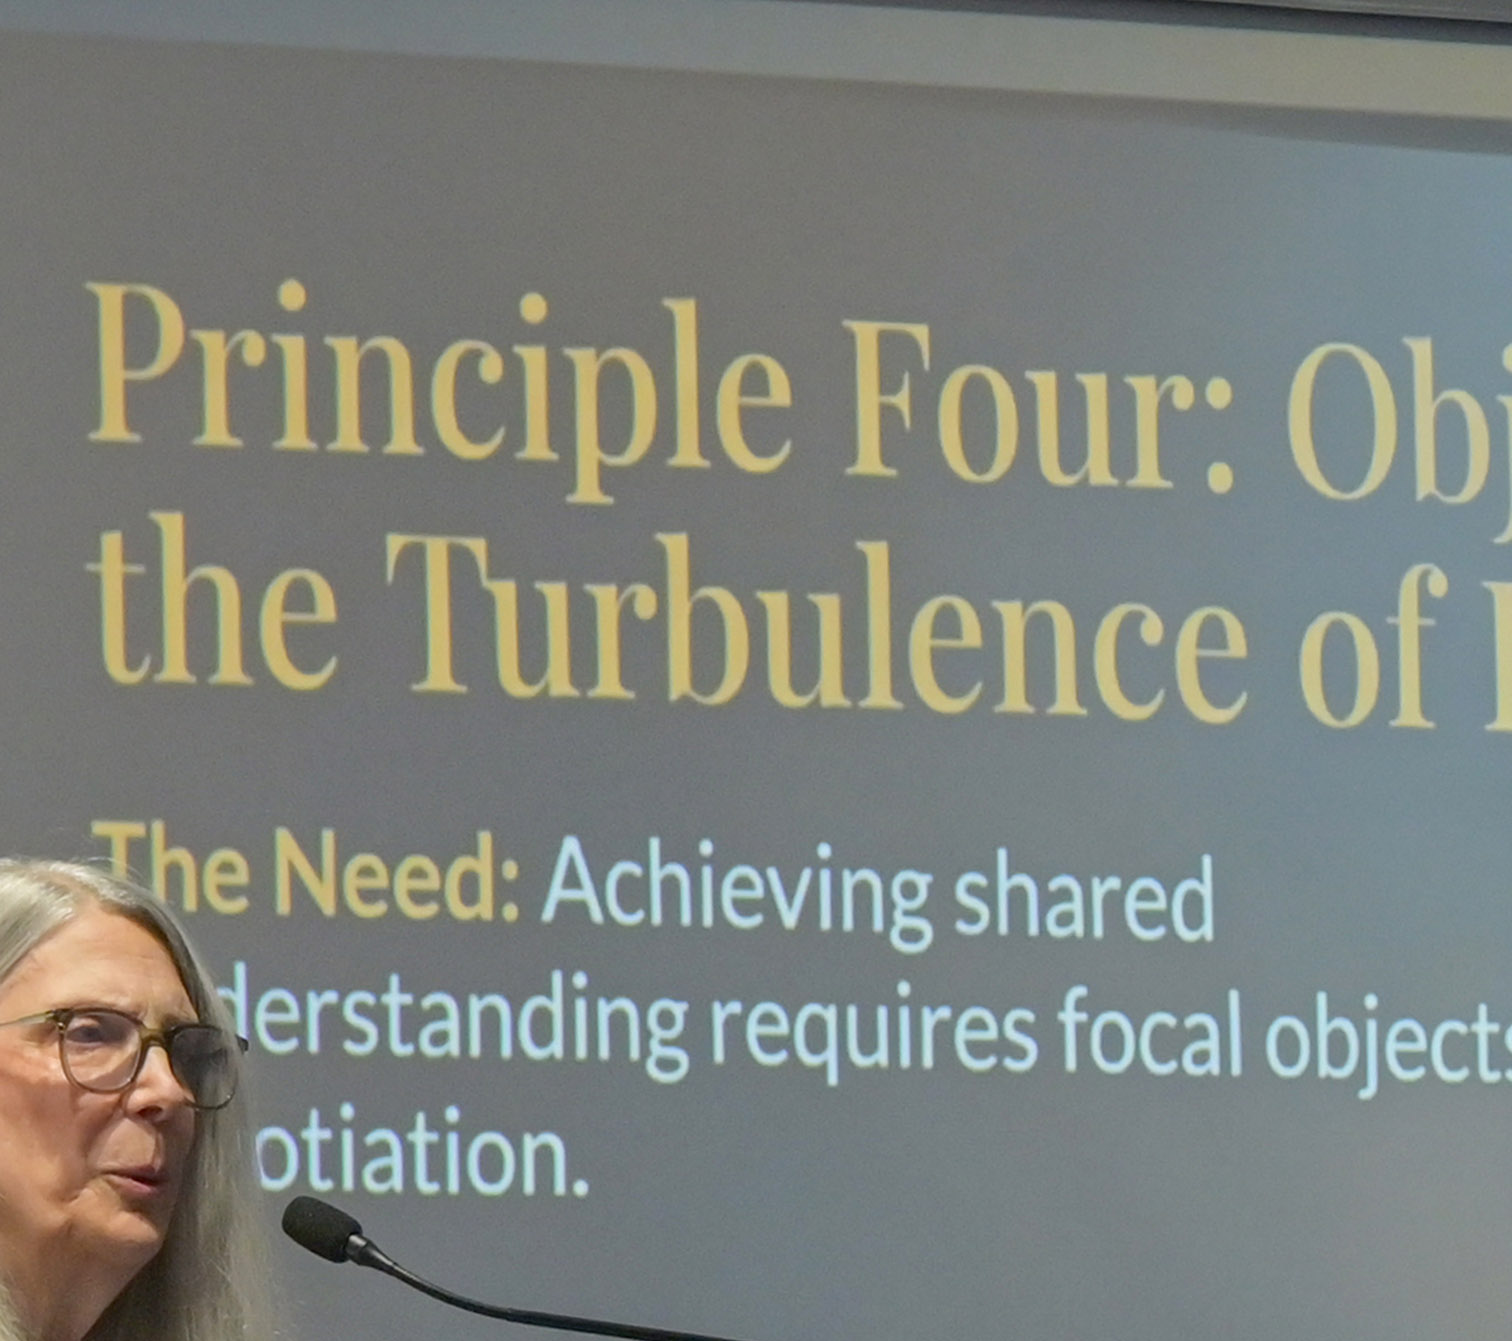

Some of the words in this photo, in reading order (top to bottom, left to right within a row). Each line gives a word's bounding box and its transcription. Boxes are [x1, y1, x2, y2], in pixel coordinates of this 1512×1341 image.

[85, 276, 793, 504] Principle
[845, 318, 1236, 496] Four:
[86, 510, 338, 692] the
[385, 530, 1251, 722] Turbulence
[1299, 562, 1448, 728] of
[90, 818, 251, 918] The
[273, 826, 520, 924] Need:
[541, 834, 934, 954] Achieving
[954, 855, 1217, 946] shared
[212, 960, 690, 1080] derstanding
[710, 990, 1038, 1088] requires
[1060, 986, 1241, 1080] focal
[254, 1102, 590, 1198] otiation.
